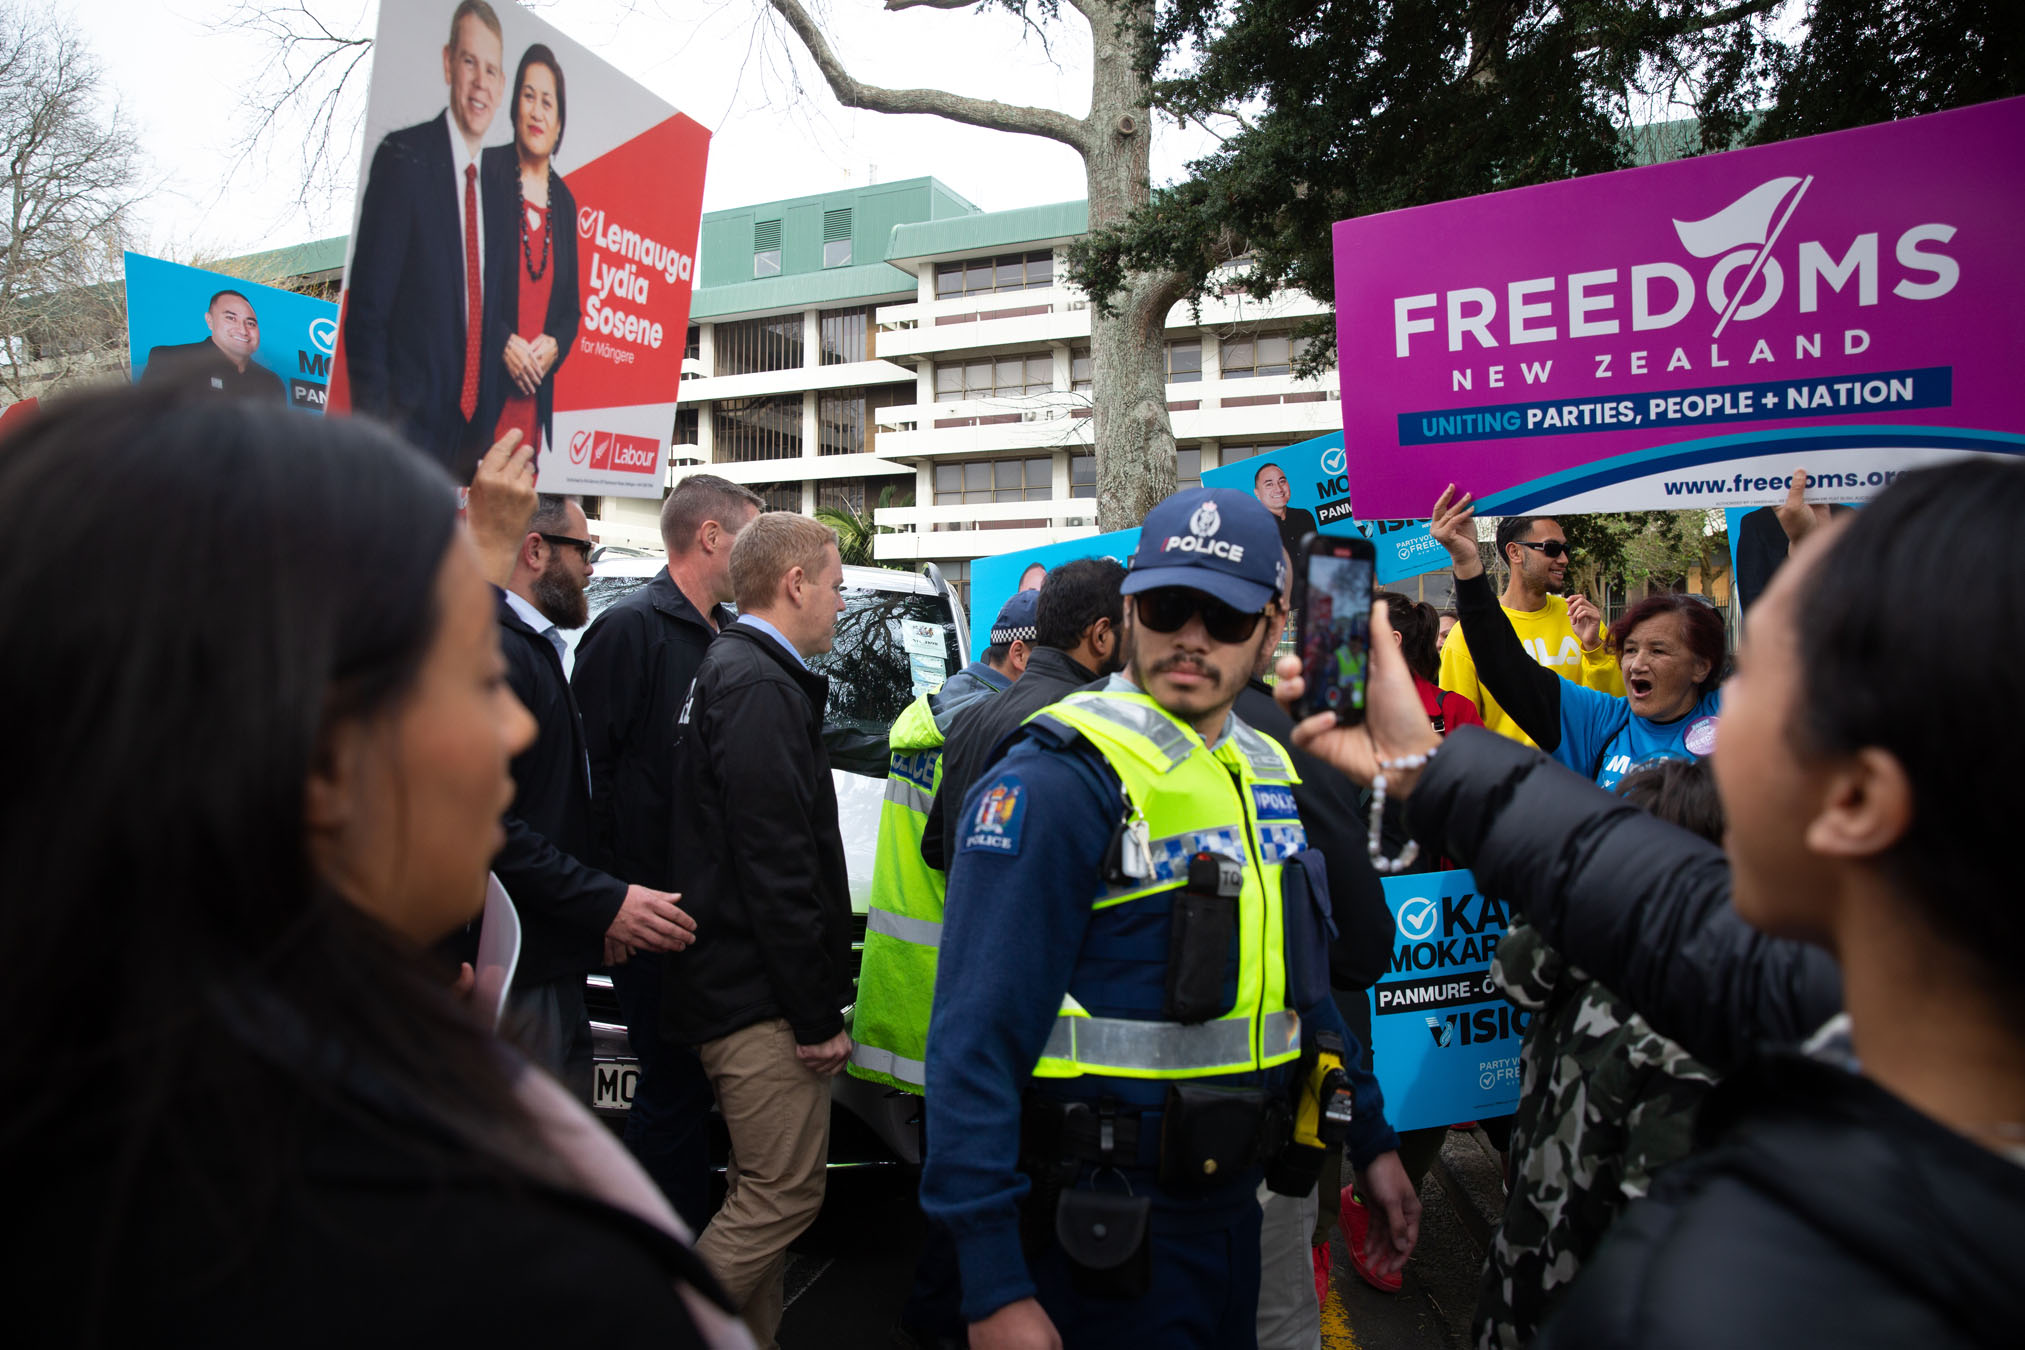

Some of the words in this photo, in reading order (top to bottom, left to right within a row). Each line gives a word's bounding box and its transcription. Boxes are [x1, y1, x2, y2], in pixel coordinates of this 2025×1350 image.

[595, 210, 692, 284] Lemauga
[589, 252, 649, 305] Lydia
[1394, 223, 1960, 358] FREEDOMS
[584, 295, 663, 349] Sosene
[581, 336, 594, 353] for
[1453, 361, 1553, 392] NEW
[1595, 329, 1871, 378] ZEALAND
[295, 386, 327, 404] PAN
[1422, 410, 1521, 437] UNITING
[1527, 401, 1642, 430] PARTIES,
[1650, 391, 1754, 420] PEOPLE
[1787, 377, 1914, 410] NATION
[614, 443, 655, 467] Labour
[1316, 475, 1349, 499] MO
[1166, 536, 1244, 563] POLICE
[1396, 538, 1418, 549] PARTY
[1419, 533, 1433, 542] VOT
[1524, 635, 1581, 667] ILA
[892, 751, 939, 785] OLICE
[1260, 791, 1298, 811] POLIC
[1442, 893, 1510, 938] KA
[1385, 935, 1501, 974] MOKAR
[1379, 981, 1471, 1008] PANMURE
[1480, 1058, 1511, 1071] PARTY
